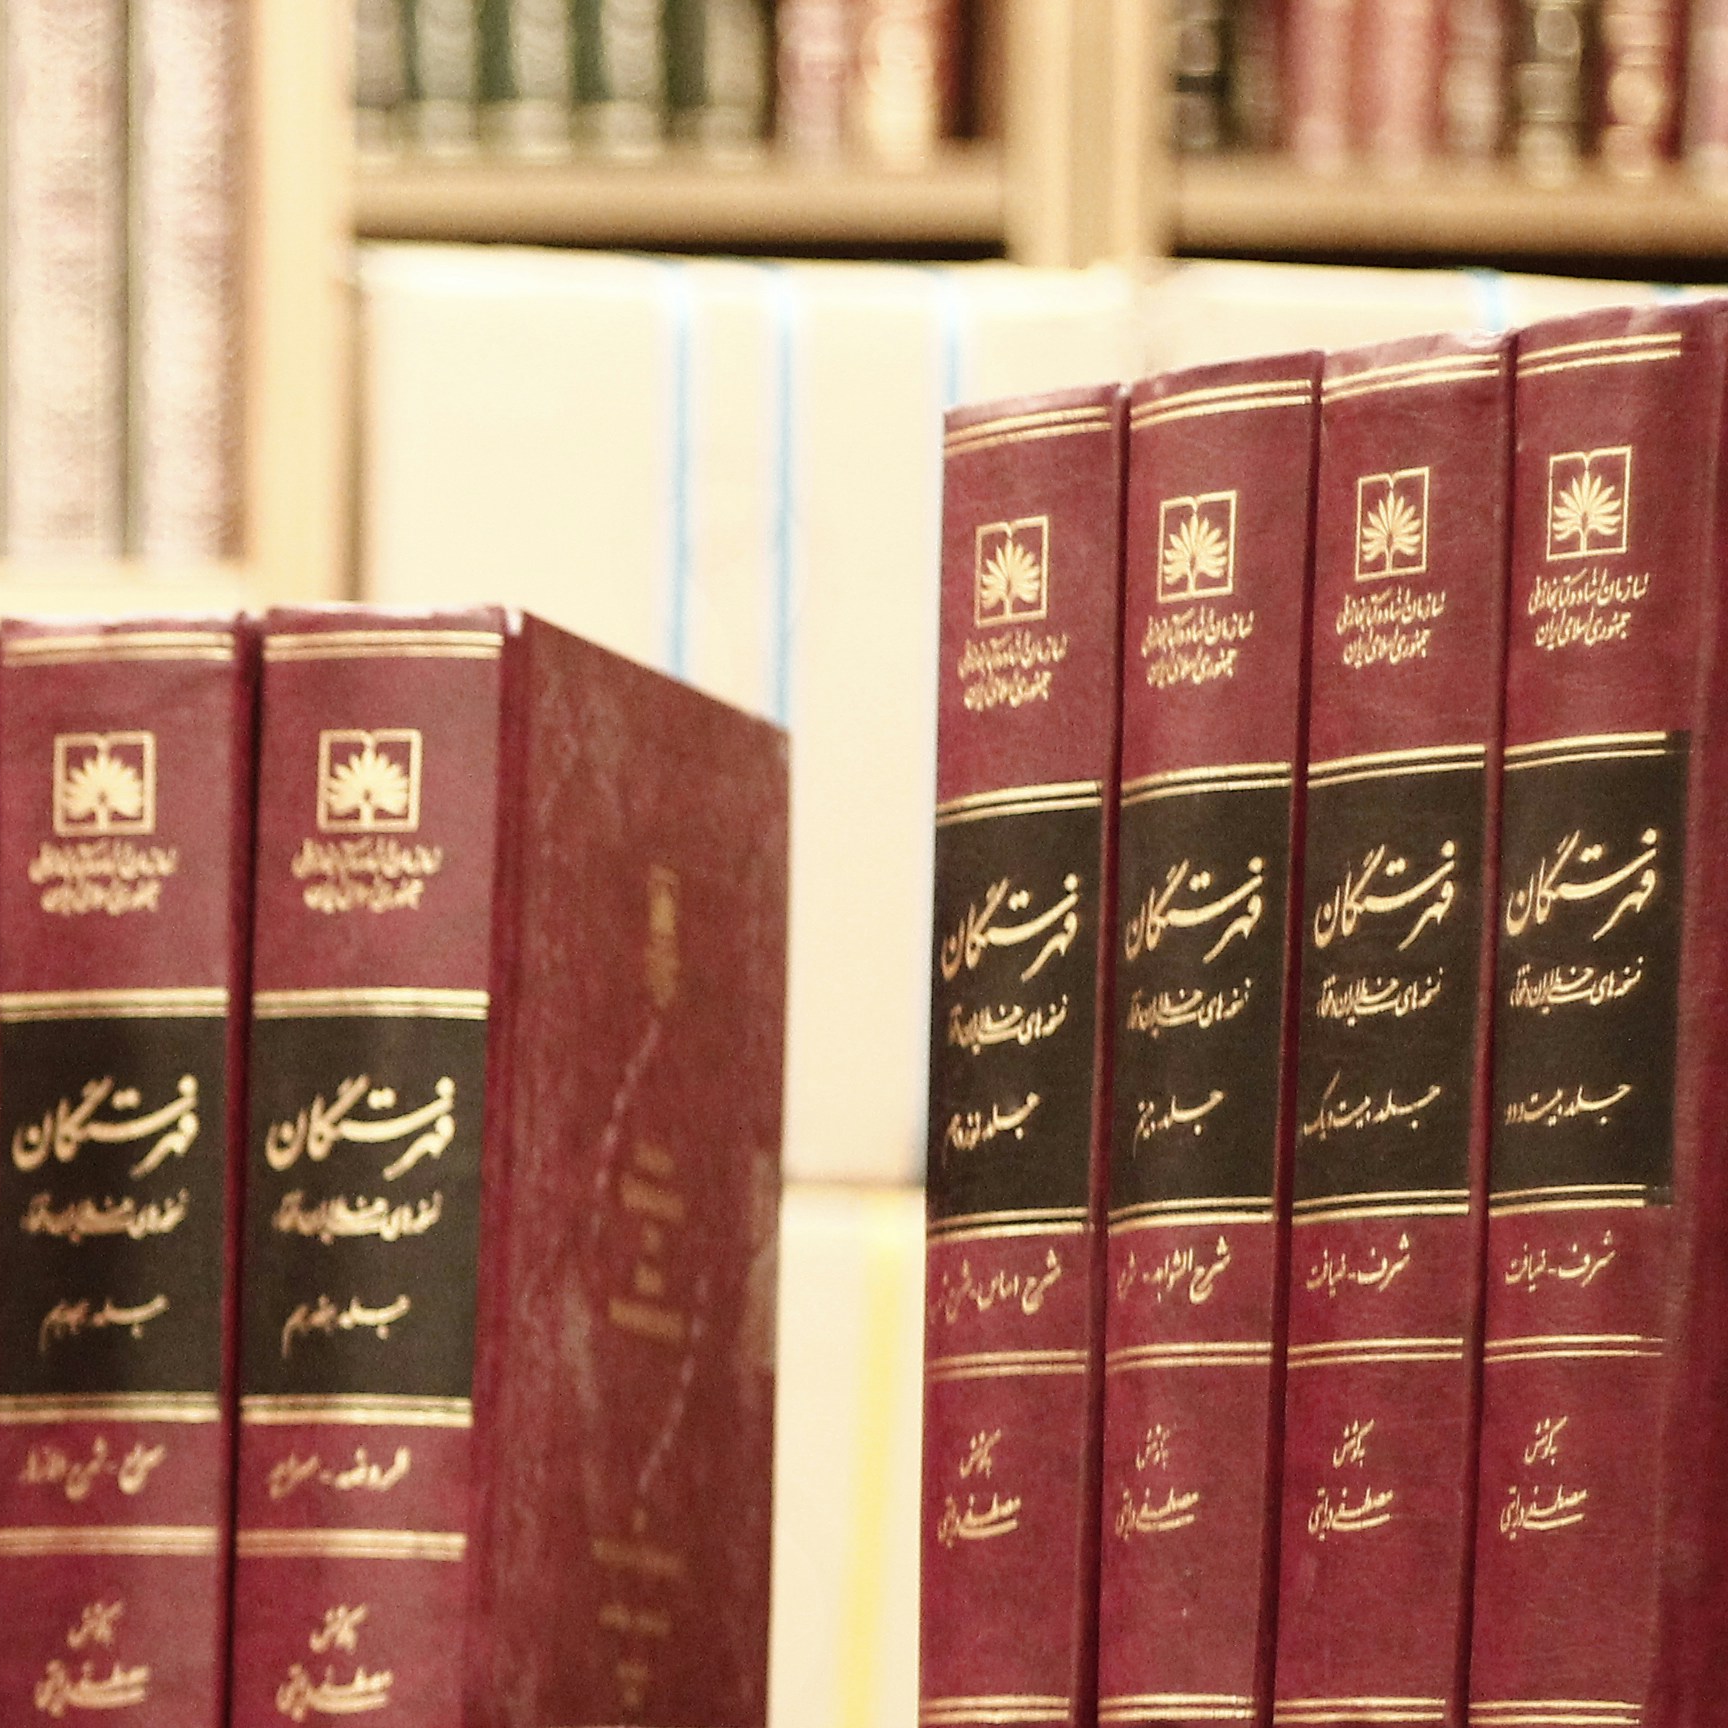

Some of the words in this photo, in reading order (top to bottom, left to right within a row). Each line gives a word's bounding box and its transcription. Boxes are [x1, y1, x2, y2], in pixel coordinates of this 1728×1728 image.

[940, 872, 1079, 982] فهرستگان
[1125, 856, 1264, 964] فهرستگان
[1314, 838, 1456, 951] فهرستگان
[1506, 829, 1657, 942] فهرستگان
[265, 1072, 457, 1183] فهرستگان
[1158, 1089, 1225, 1137] جلد
[1368, 1084, 1442, 1130] جلد
[1562, 1083, 1633, 1126] جلد
